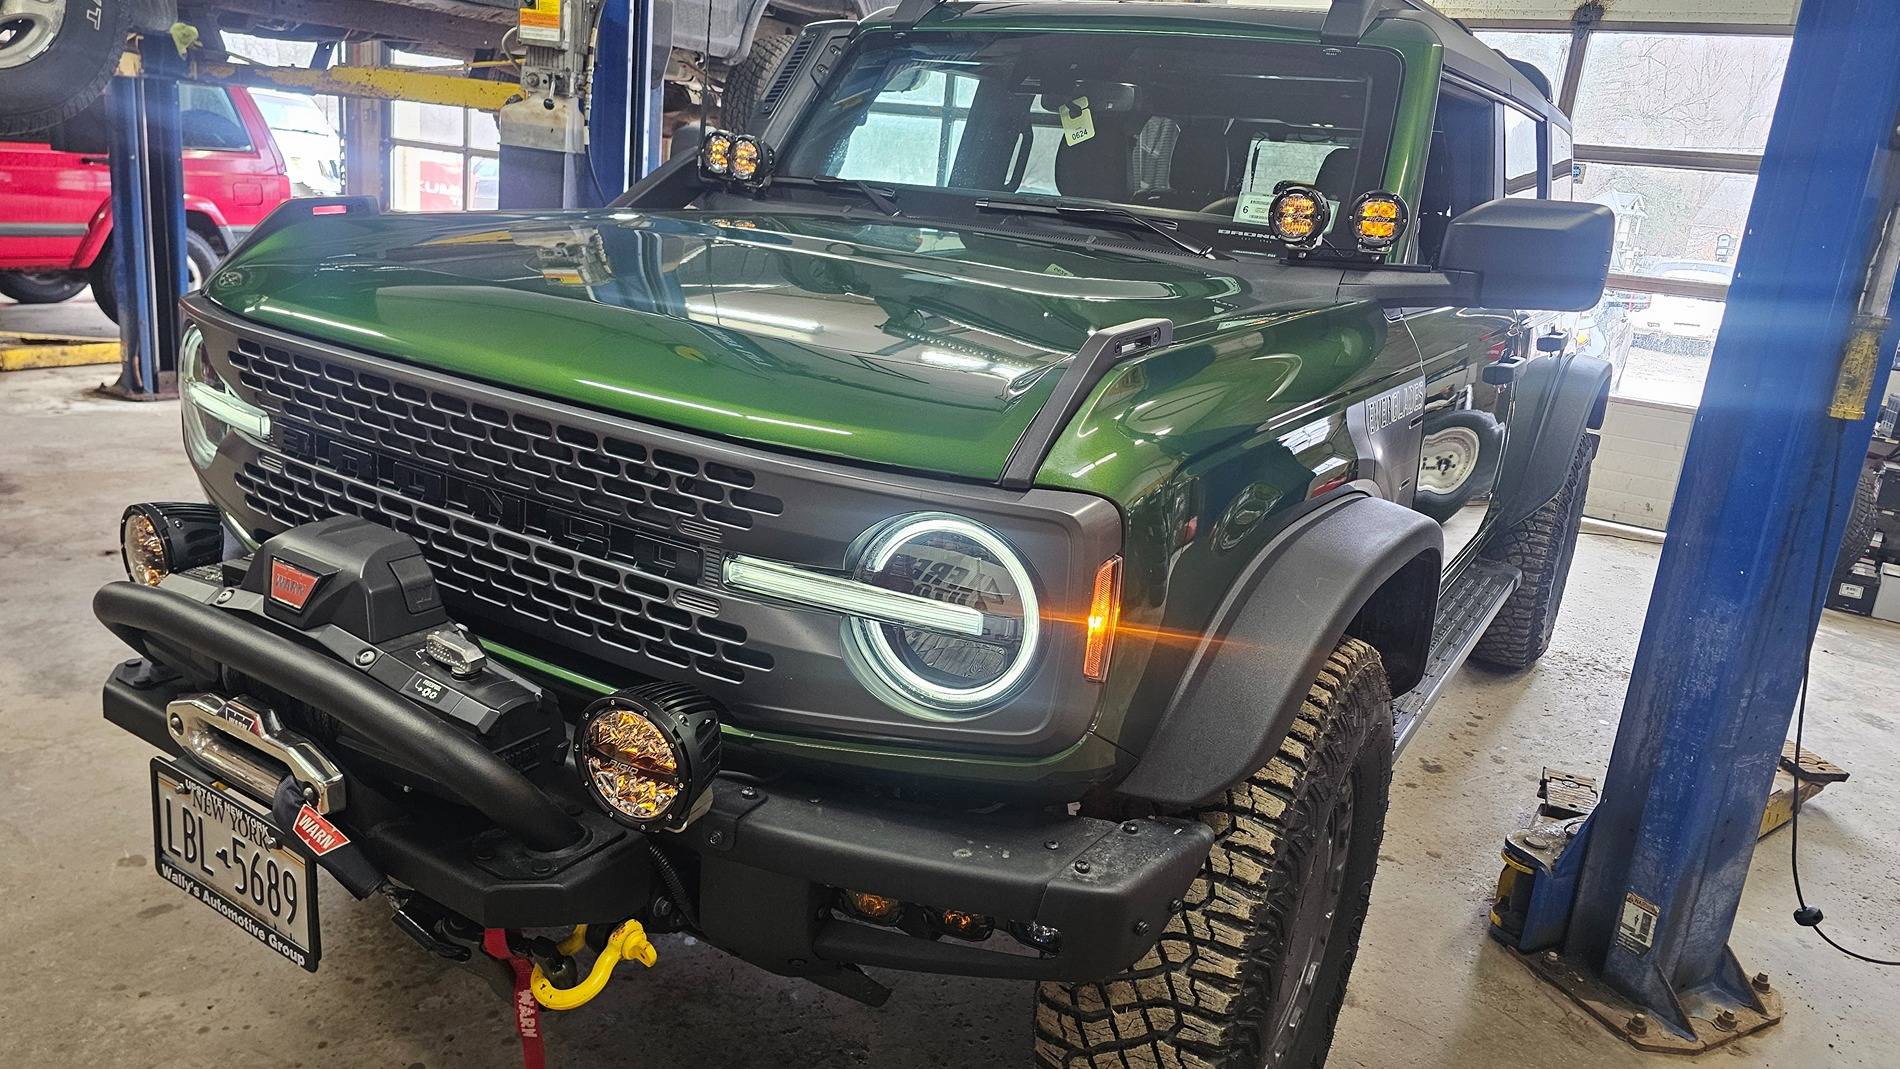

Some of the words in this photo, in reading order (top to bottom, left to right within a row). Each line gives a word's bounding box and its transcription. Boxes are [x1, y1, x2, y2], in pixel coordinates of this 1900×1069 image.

[1071, 128, 1088, 141] 0624
[1367, 380, 1424, 435] EVERGLADES
[281, 425, 703, 584] BRONCO
[275, 574, 306, 596] WARN
[608, 760, 639, 775] RIGID
[184, 778, 222, 808] UPSTATE
[223, 801, 245, 819] NEW
[245, 815, 269, 836] YORK
[191, 792, 226, 824] NEW
[230, 812, 271, 853] YORK
[298, 813, 336, 850] WARN
[161, 862, 200, 898] Wally's
[202, 891, 266, 942] Automotive
[267, 931, 306, 967] Group
[517, 989, 538, 1038] WARN
